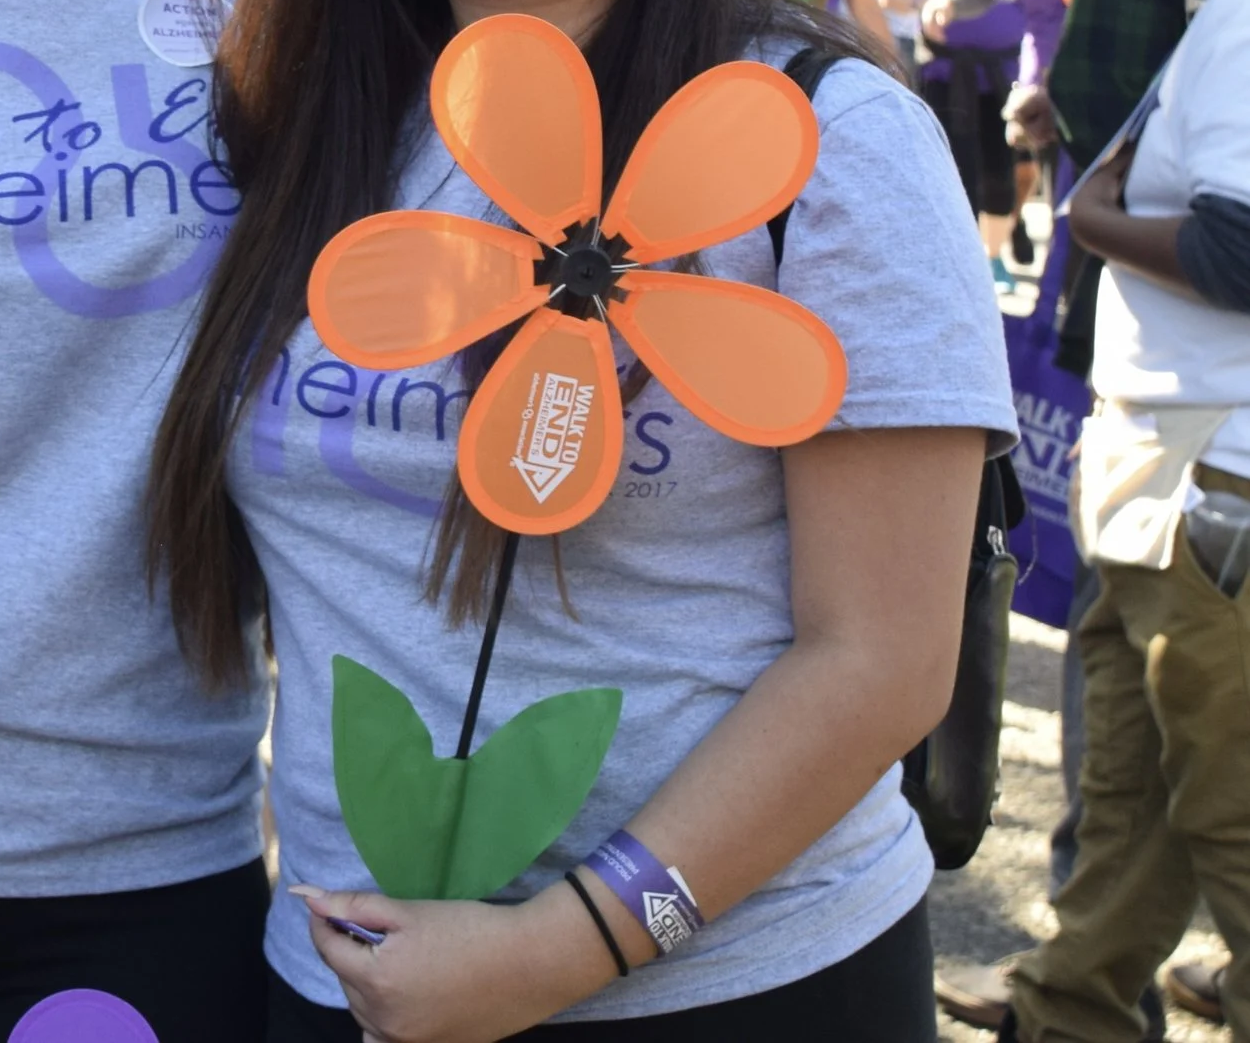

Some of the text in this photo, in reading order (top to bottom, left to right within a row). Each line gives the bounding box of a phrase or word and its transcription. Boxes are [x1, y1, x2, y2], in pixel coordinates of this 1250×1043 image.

[12, 97, 103, 152] to
[175, 223, 231, 239] INSA
[542, 381, 573, 459] END
[561, 384, 595, 464] WALK TO
[624, 482, 678, 498] 2017
